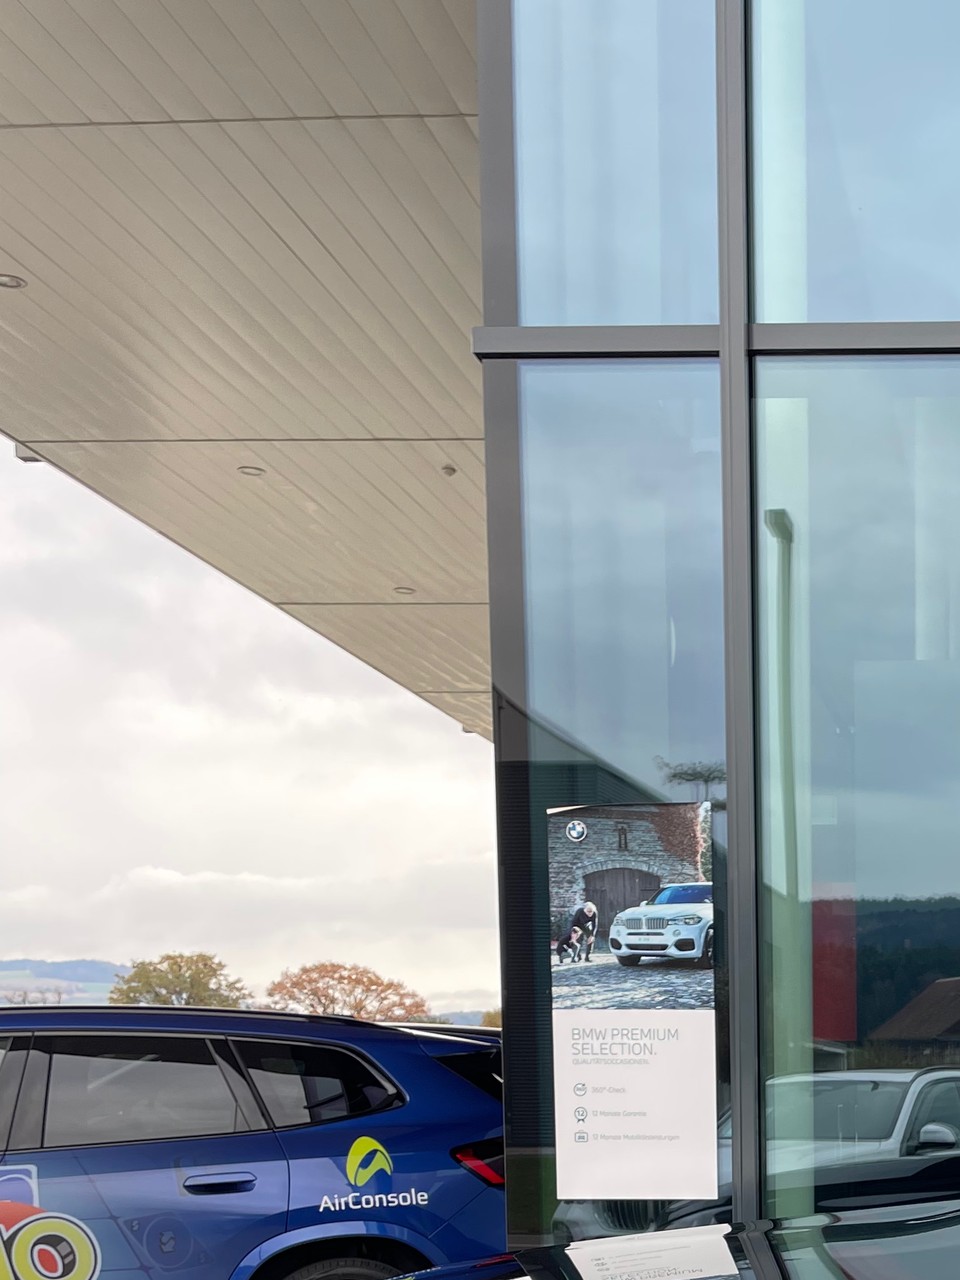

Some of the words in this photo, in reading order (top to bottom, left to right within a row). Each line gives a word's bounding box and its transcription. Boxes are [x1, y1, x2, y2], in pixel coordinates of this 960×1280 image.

[571, 1028, 607, 1041] BMW
[611, 1028, 679, 1041] PREMIUM
[571, 1042, 657, 1056] SELECTION.
[319, 1188, 428, 1212] AirConsole
